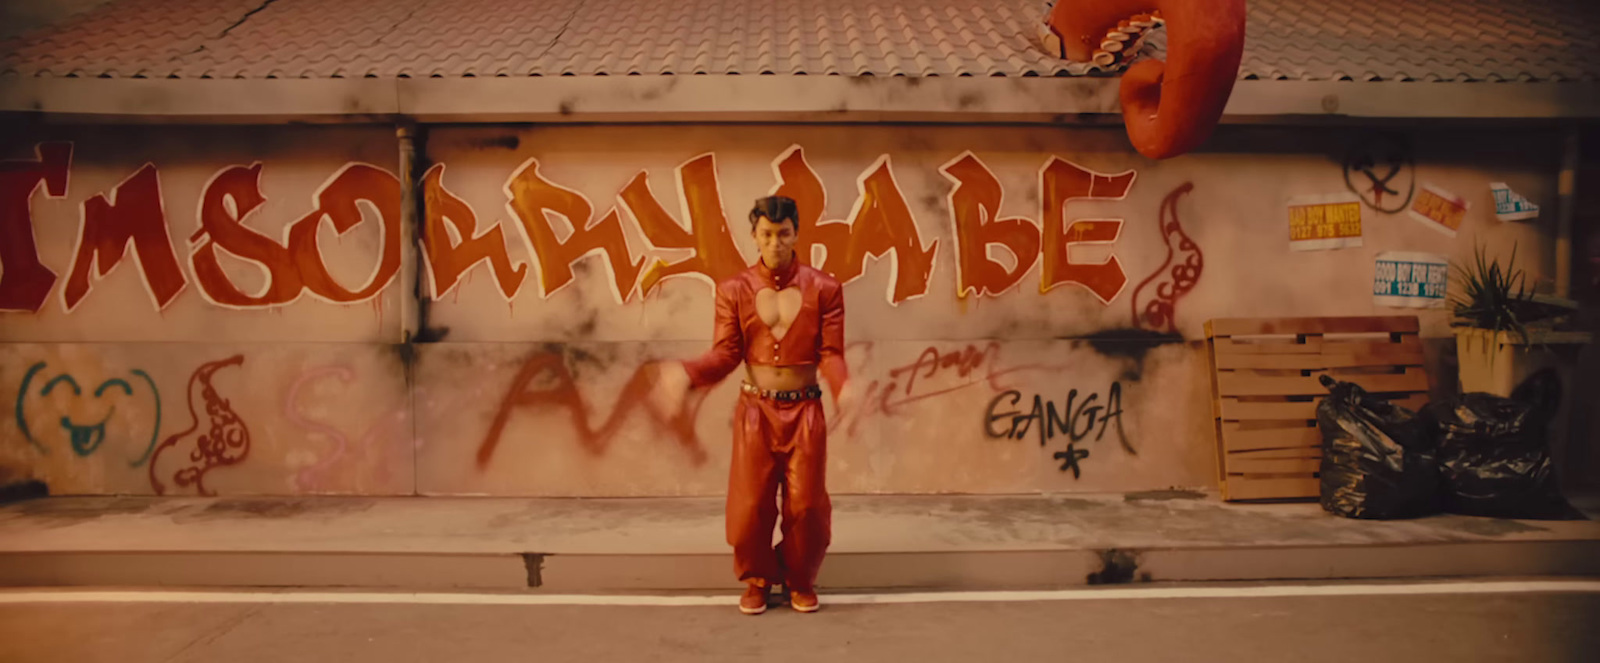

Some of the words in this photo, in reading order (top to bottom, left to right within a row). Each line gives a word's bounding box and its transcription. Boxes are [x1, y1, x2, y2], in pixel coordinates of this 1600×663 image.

[1375, 262, 1396, 281] GOOD
[1398, 263, 1411, 282] BOY
[1412, 263, 1427, 283] FOR
[984, 381, 1137, 455] GANGA
